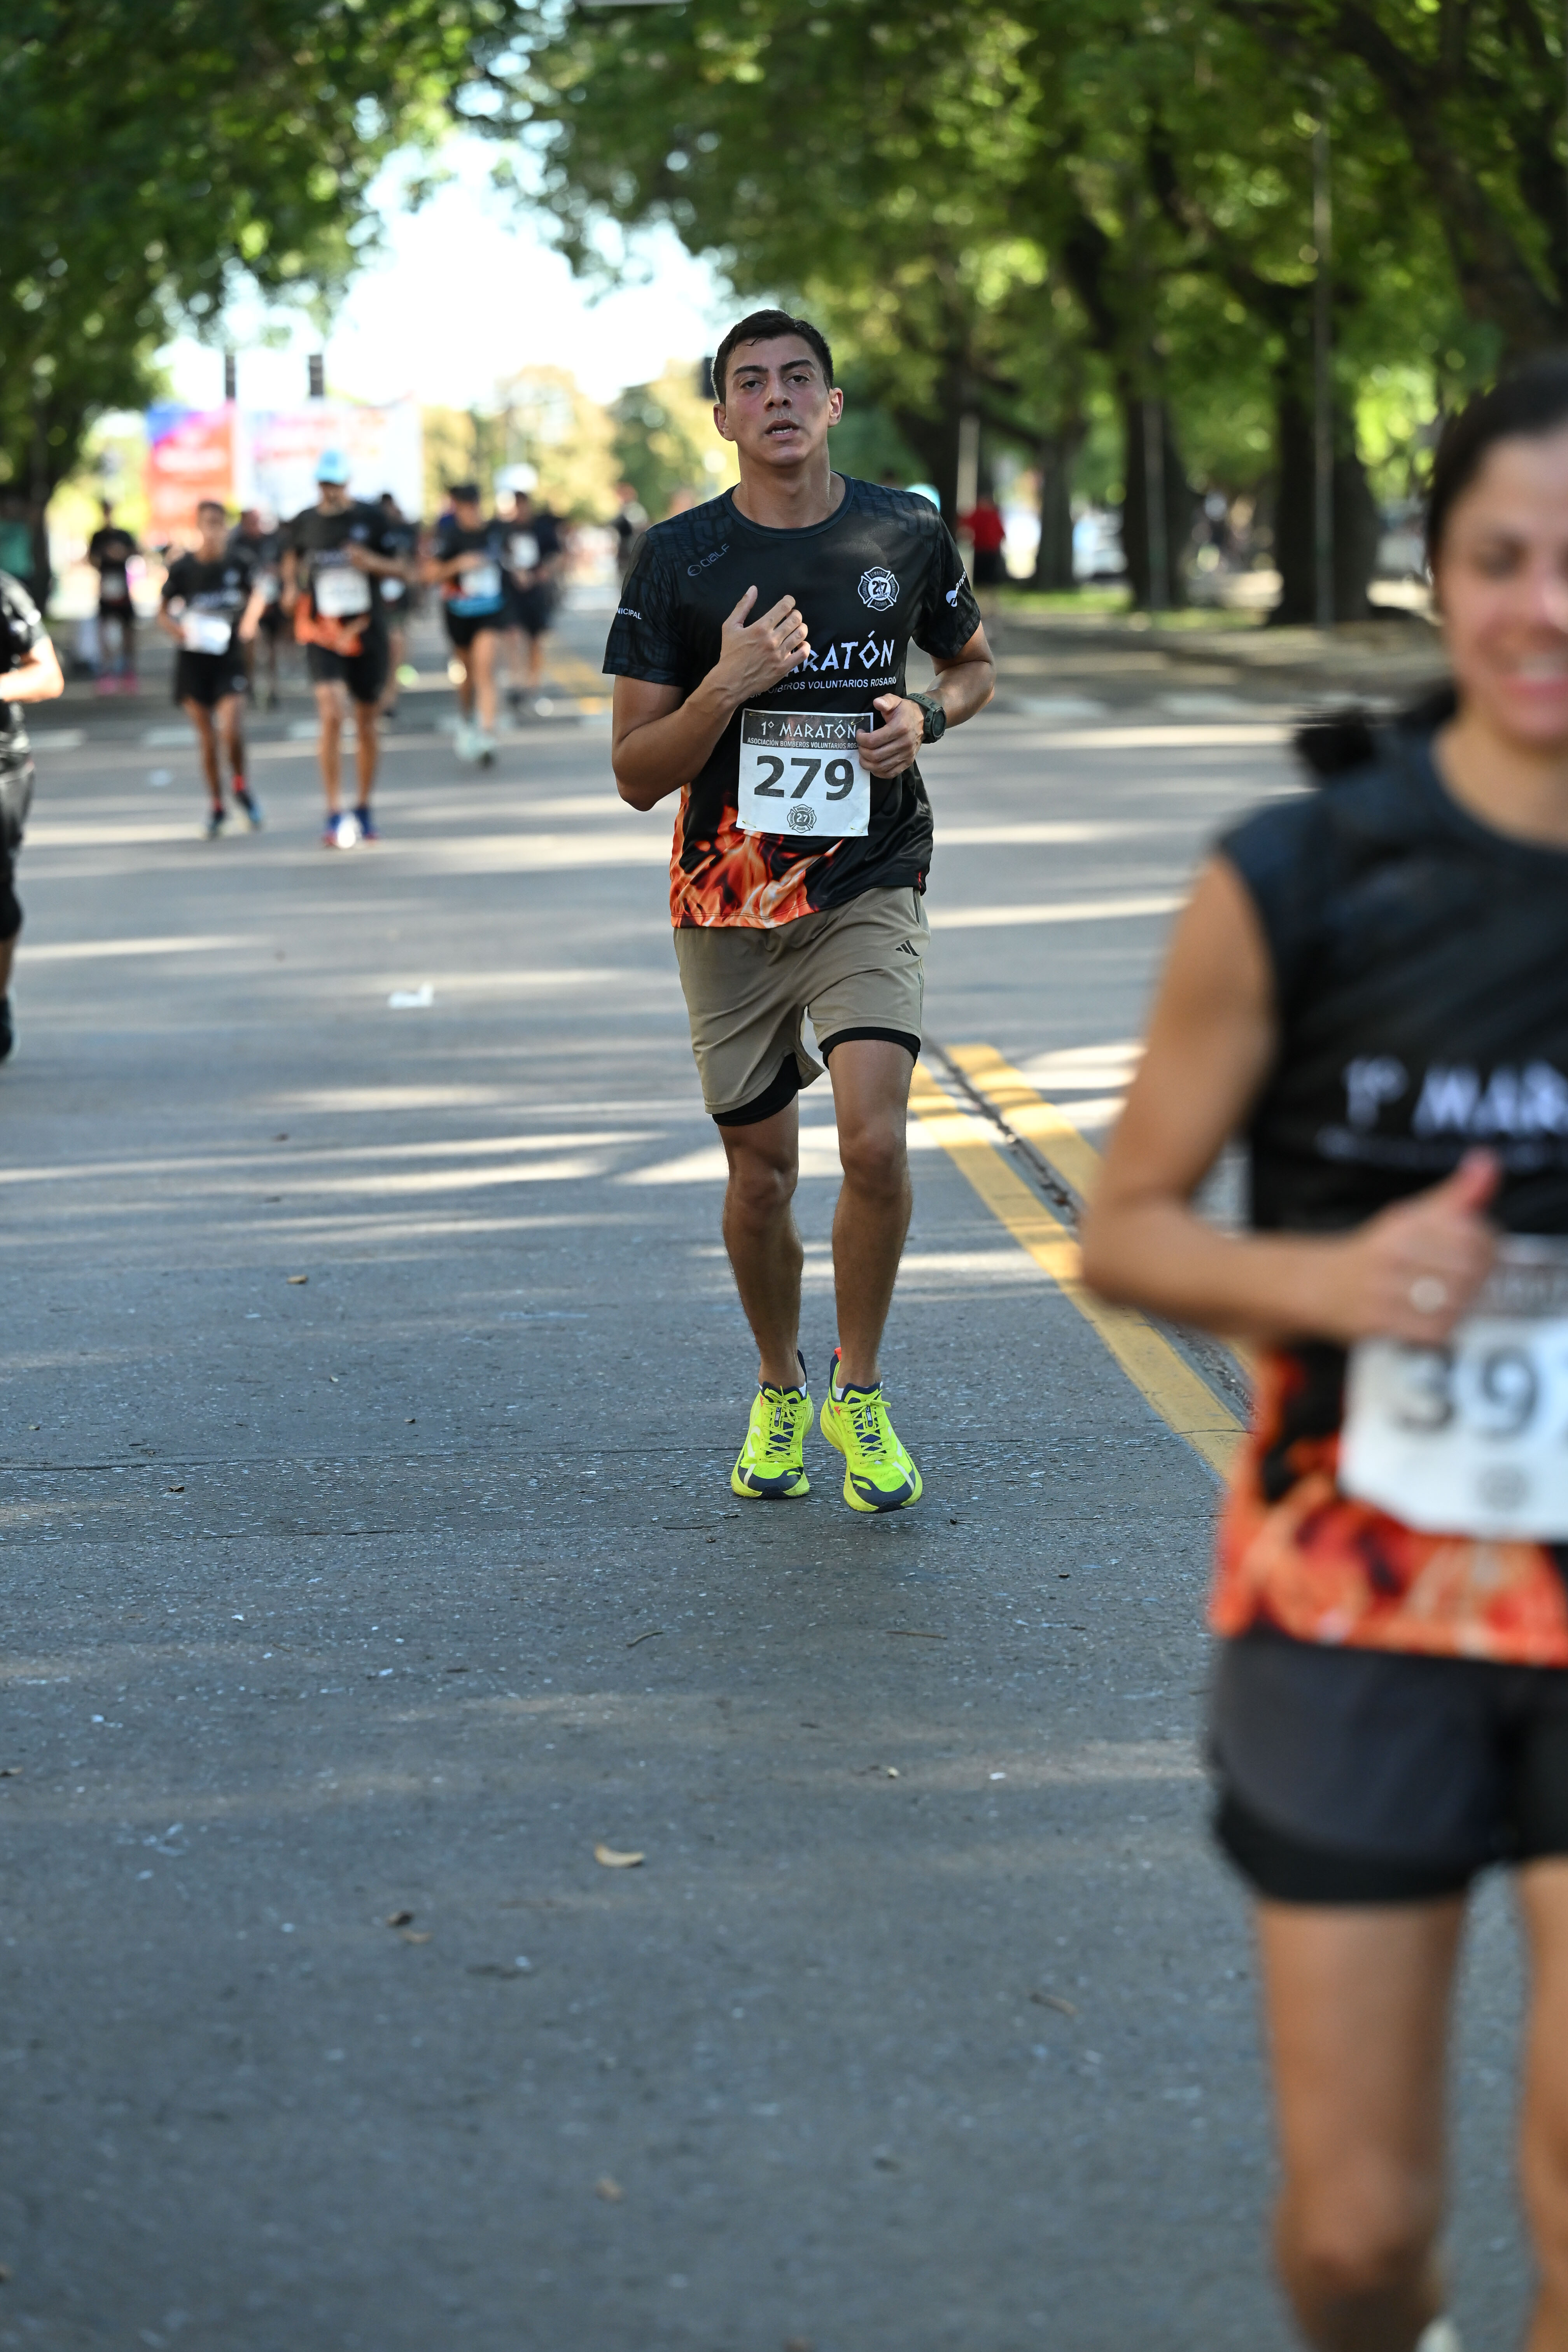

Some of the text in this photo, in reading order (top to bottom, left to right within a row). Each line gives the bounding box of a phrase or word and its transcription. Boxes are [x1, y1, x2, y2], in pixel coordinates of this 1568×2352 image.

[872, 581, 887, 595] 27
[808, 679, 868, 690] VOLUNTARIOS
[870, 676, 896, 688] ROSARIO
[779, 720, 856, 739] MARATÓN
[747, 737, 779, 746] ASOCIACIÓN
[754, 755, 854, 801] 279
[796, 813, 808, 822] 27
[1386, 1344, 1568, 1443] 39
